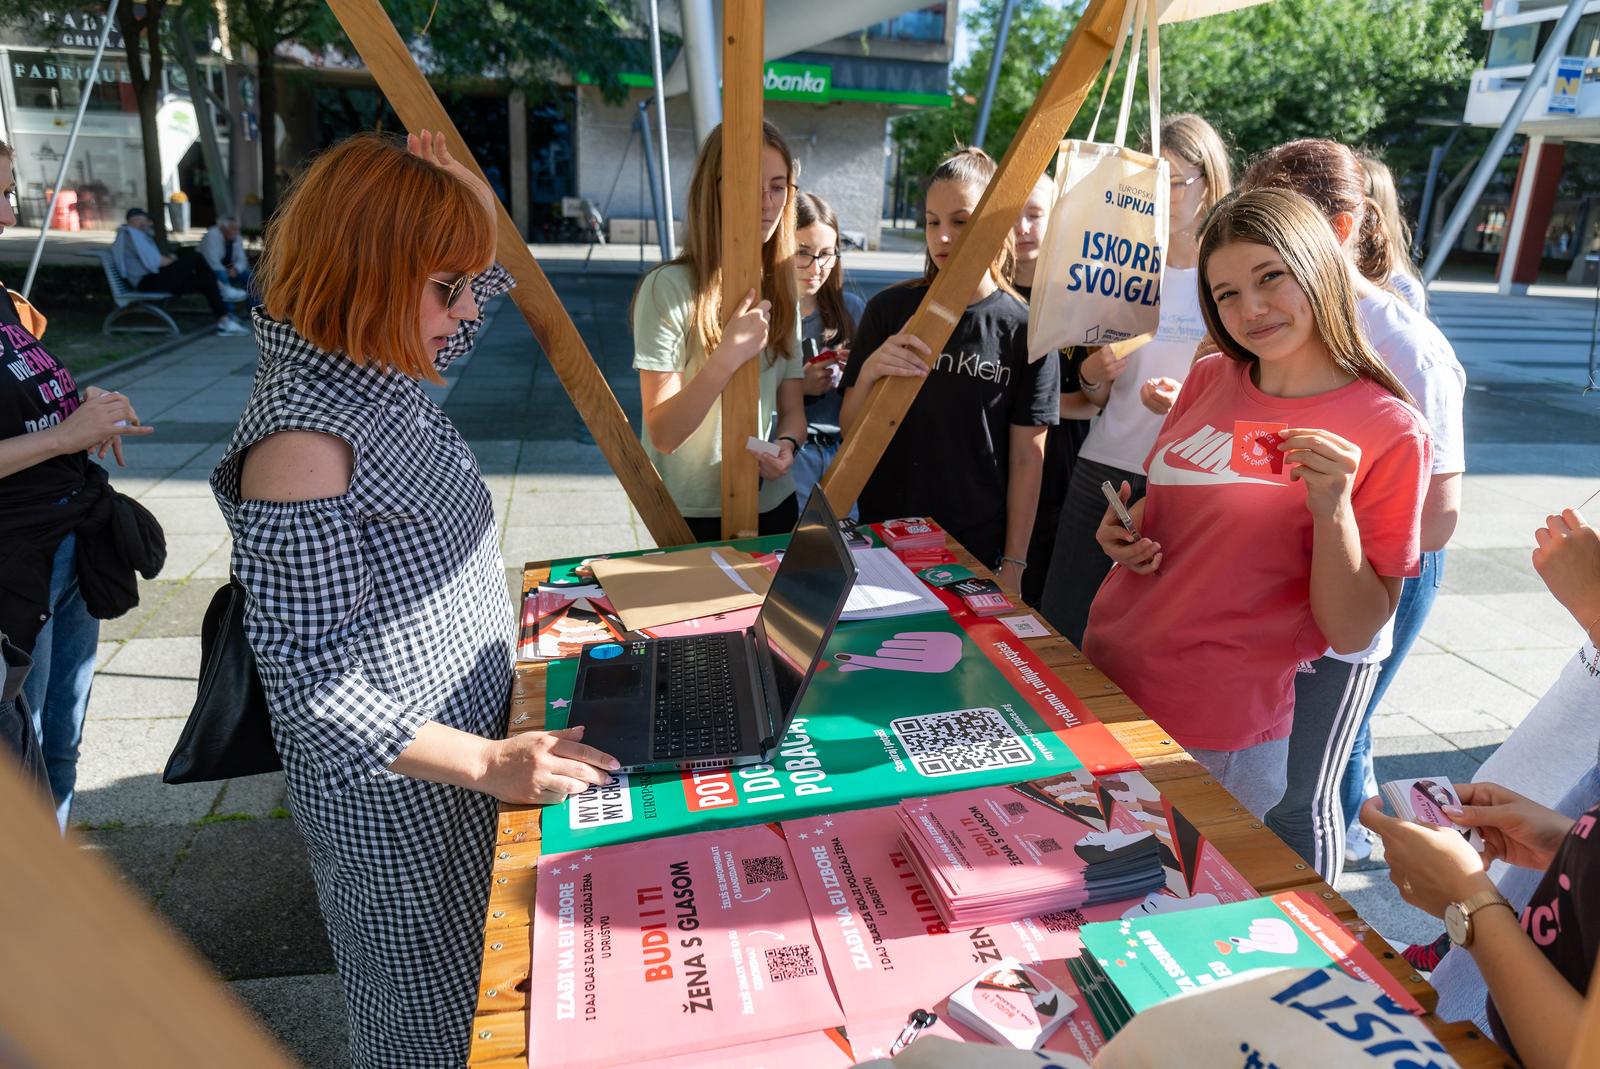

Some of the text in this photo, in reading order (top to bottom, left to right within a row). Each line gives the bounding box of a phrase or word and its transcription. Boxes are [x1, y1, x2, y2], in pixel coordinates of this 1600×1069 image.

[763, 68, 826, 93] banka
[1105, 190, 1115, 205] 9.
[1067, 263, 1122, 299] SVOJ
[957, 351, 1011, 387] Klein
[1242, 429, 1275, 444] MY VOICE
[1241, 451, 1274, 466] MY CHOICE
[993, 641, 1082, 728] Trebamo 1 milijun potpisa!
[644, 776, 657, 820] EUROPSK
[692, 768, 735, 808] POT
[747, 793, 785, 803] I
[578, 802, 600, 823] MY
[602, 801, 623, 821] MY
[960, 817, 974, 827] TI
[968, 806, 999, 837] GLASOM
[831, 837, 846, 858] ŽENA
[972, 833, 999, 857] BUDI
[1001, 844, 1024, 867] ŽENA
[580, 872, 593, 895] ŽENA
[838, 855, 860, 890] POLOŽAJ
[811, 845, 873, 971] IZAĐI NA EU IZBORE
[852, 888, 869, 911] BOLJI
[862, 877, 888, 916] U DRUŠTVU
[581, 894, 594, 928] POLOŽAJ
[863, 911, 875, 924] ZA
[583, 929, 594, 954] BOLJI
[598, 915, 612, 959] U DRUŠTVU
[637, 886, 673, 983] BUDI I TI
[669, 861, 713, 1014] ŽENA S GLASOM
[867, 923, 883, 945] GLAS
[970, 927, 1003, 963] ŽEN
[557, 882, 576, 1021] IZAĐI NA EU IZBORE
[584, 954, 595, 967] ZA
[876, 946, 892, 965] DAJ
[584, 967, 595, 991] GLAS
[585, 993, 596, 1013] DAJ
